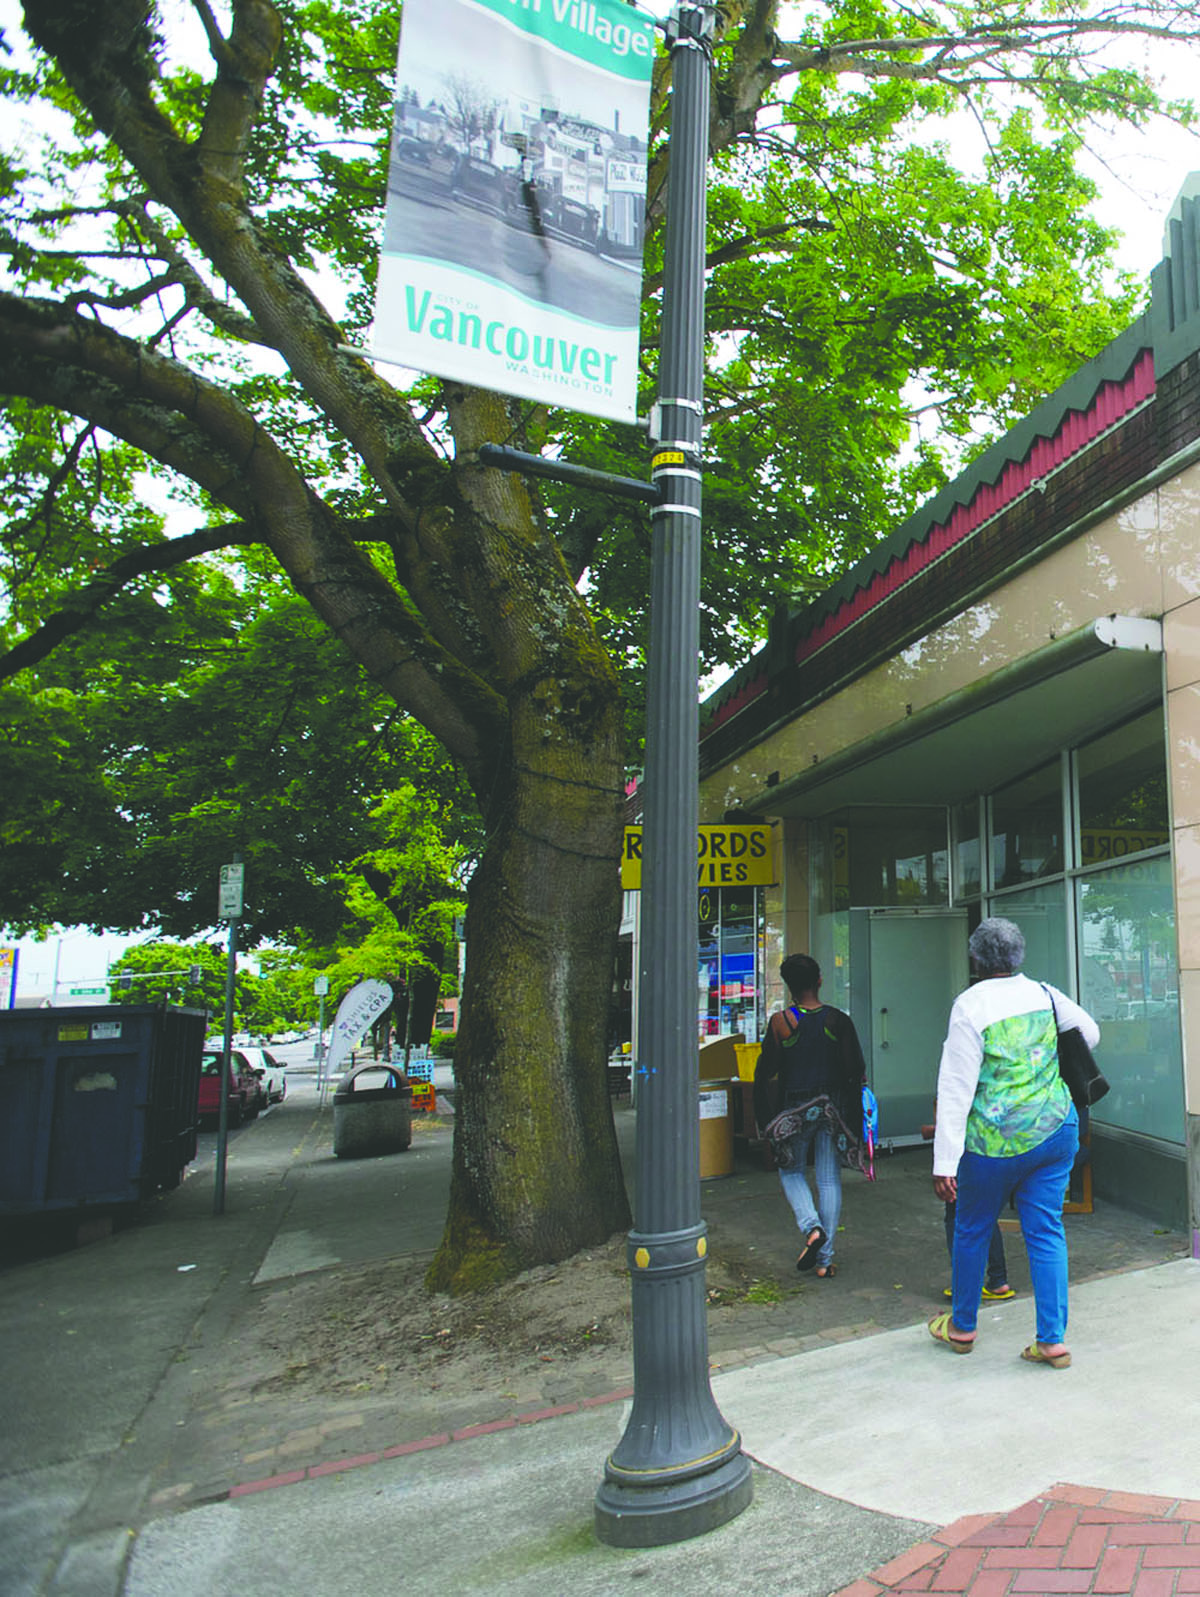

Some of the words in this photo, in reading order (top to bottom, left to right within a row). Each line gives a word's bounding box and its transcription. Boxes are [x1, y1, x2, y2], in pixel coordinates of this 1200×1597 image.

[552, 0, 649, 56] Village
[405, 285, 618, 385] Vancouver
[505, 361, 614, 397] WASHINGTON
[626, 831, 767, 860] RORDS
[342, 1021, 363, 1041] TAX
[369, 994, 388, 1012] CPA
